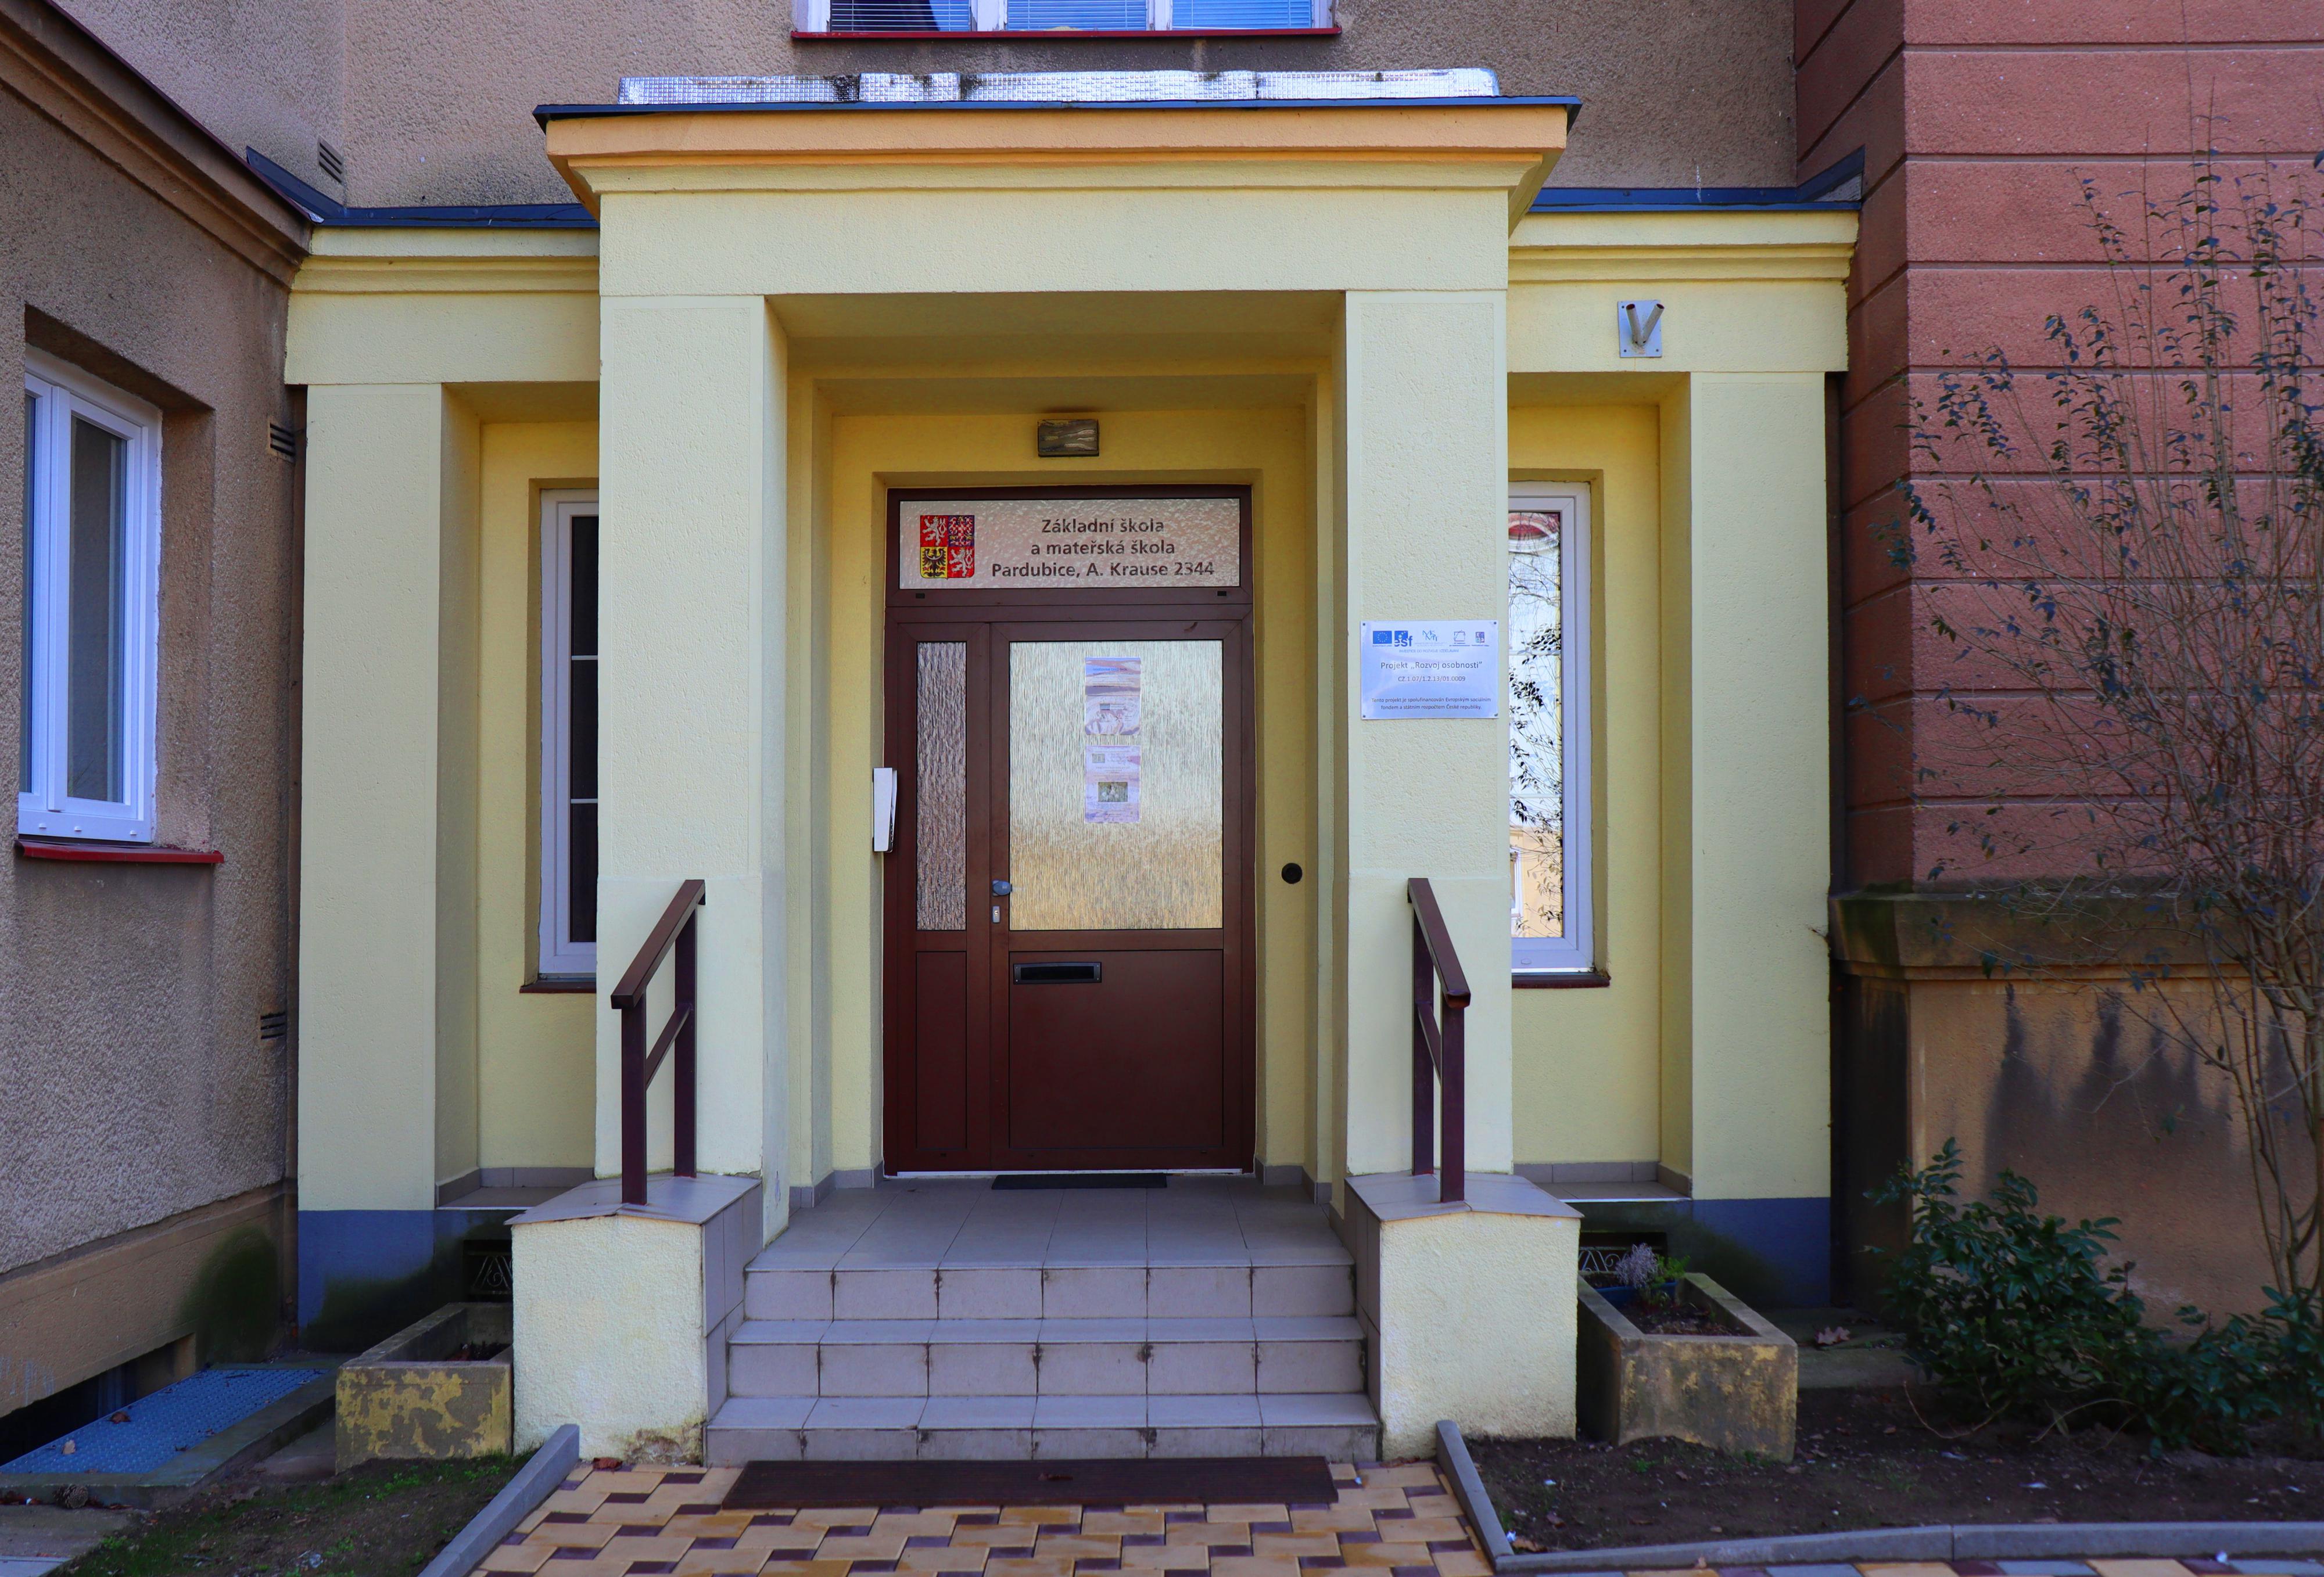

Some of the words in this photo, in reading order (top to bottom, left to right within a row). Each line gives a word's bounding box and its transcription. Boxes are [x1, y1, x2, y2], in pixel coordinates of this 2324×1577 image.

[1041, 518, 1114, 533] Základní
[1120, 519, 1164, 533] škola
[1031, 543, 1040, 555] a
[1047, 539, 1125, 555] mateřská
[1131, 539, 1175, 555] škola
[992, 563, 1080, 579] Pardubice,
[1086, 563, 1103, 577] A.
[1110, 563, 1168, 577] Krause
[1174, 562, 1214, 576] 2344
[1394, 635, 1412, 646] esf
[1380, 662, 1408, 670] Projekt
